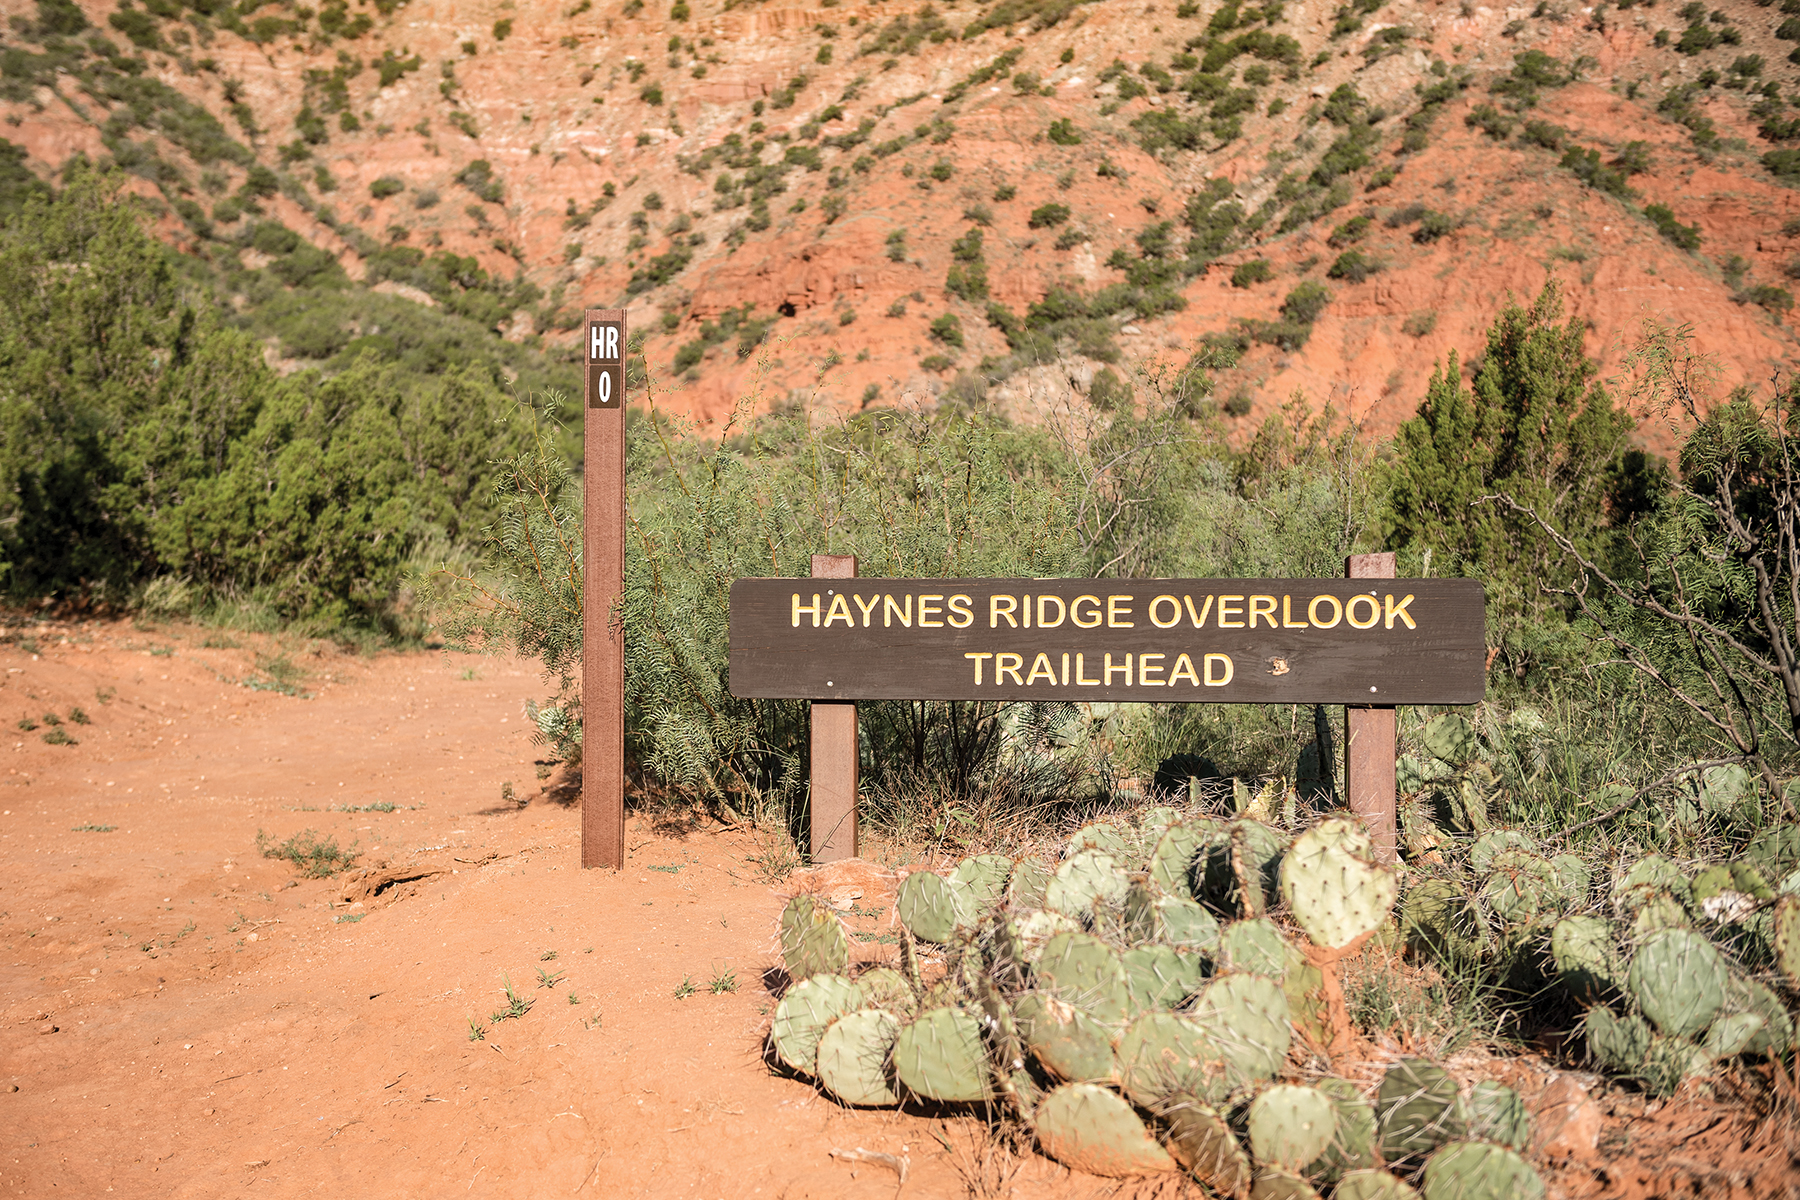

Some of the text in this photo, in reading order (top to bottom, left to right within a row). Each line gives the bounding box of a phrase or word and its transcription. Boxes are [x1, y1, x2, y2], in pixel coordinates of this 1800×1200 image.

[591, 326, 619, 359] HR
[598, 370, 612, 403] 0
[791, 593, 1417, 630] HAYNES RIDGE OVERLOOK
[964, 652, 1235, 687] TRAILHEAD
